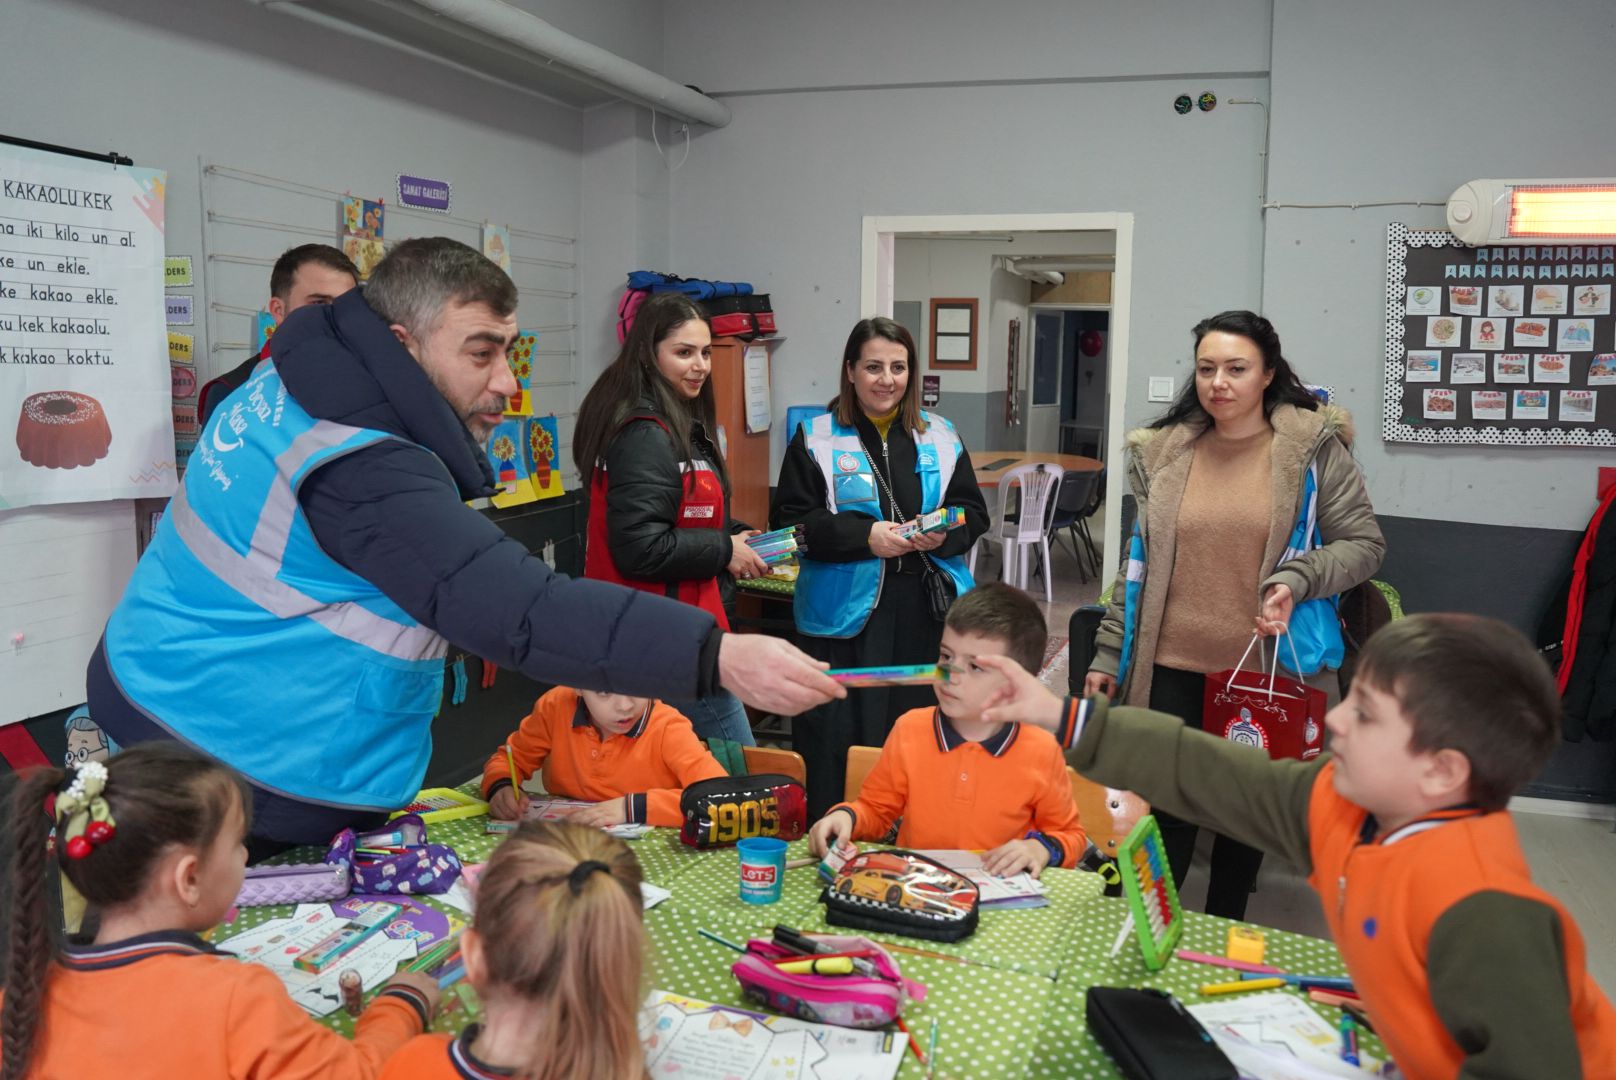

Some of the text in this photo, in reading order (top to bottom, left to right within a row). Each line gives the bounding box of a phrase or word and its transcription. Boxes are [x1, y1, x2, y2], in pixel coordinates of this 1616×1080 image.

[4, 180, 113, 211] KAKAOLU KEK
[403, 183, 421, 197] SANAT
[27, 221, 43, 239] iki
[55, 223, 79, 242] kilo
[92, 233, 108, 245] un
[120, 231, 136, 248] al.
[28, 260, 45, 272] un
[57, 256, 90, 276] ekle.
[30, 283, 73, 302] kakao
[86, 287, 118, 306] ekle.
[19, 315, 44, 333] kek
[51, 316, 110, 335] kakaolu.
[13, 347, 55, 364] kakao
[67, 348, 114, 366] koktu.
[169, 341, 189, 353] DERS
[708, 797, 779, 843] 1905
